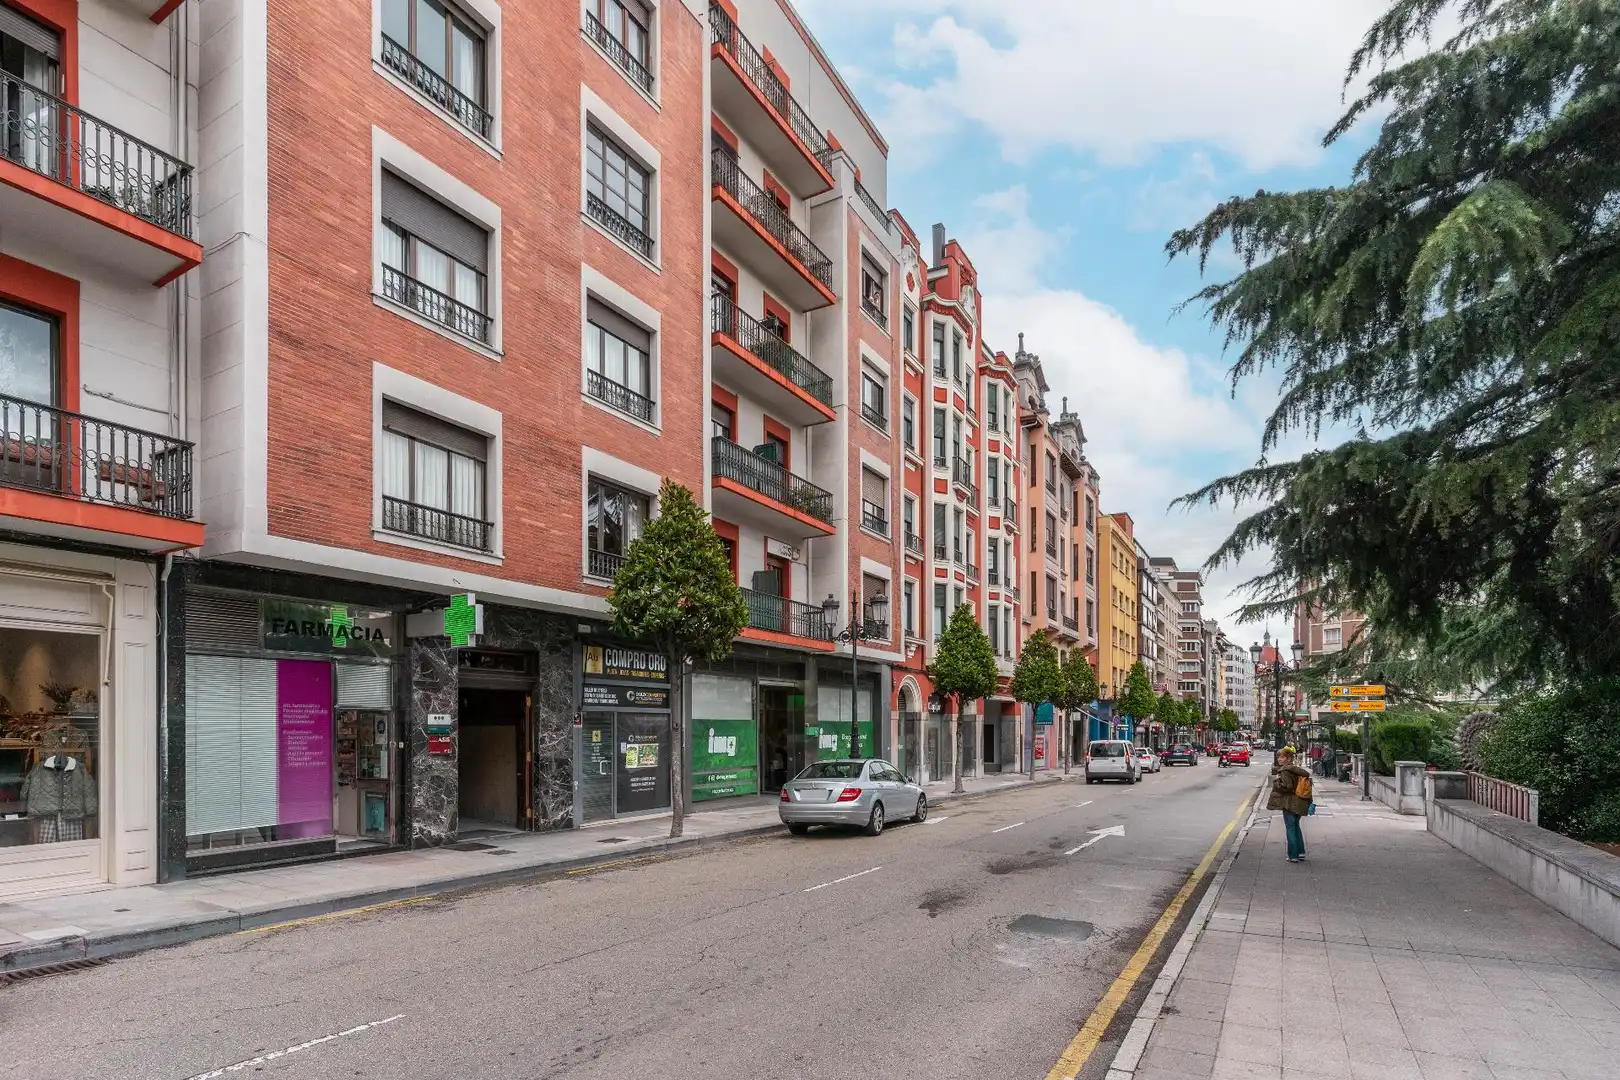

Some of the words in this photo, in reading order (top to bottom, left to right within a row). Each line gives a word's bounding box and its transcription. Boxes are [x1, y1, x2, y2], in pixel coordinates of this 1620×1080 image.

[271, 618, 386, 642] FARMACIA
[605, 648, 646, 669] COMPRO
[648, 654, 666, 672] ORO
